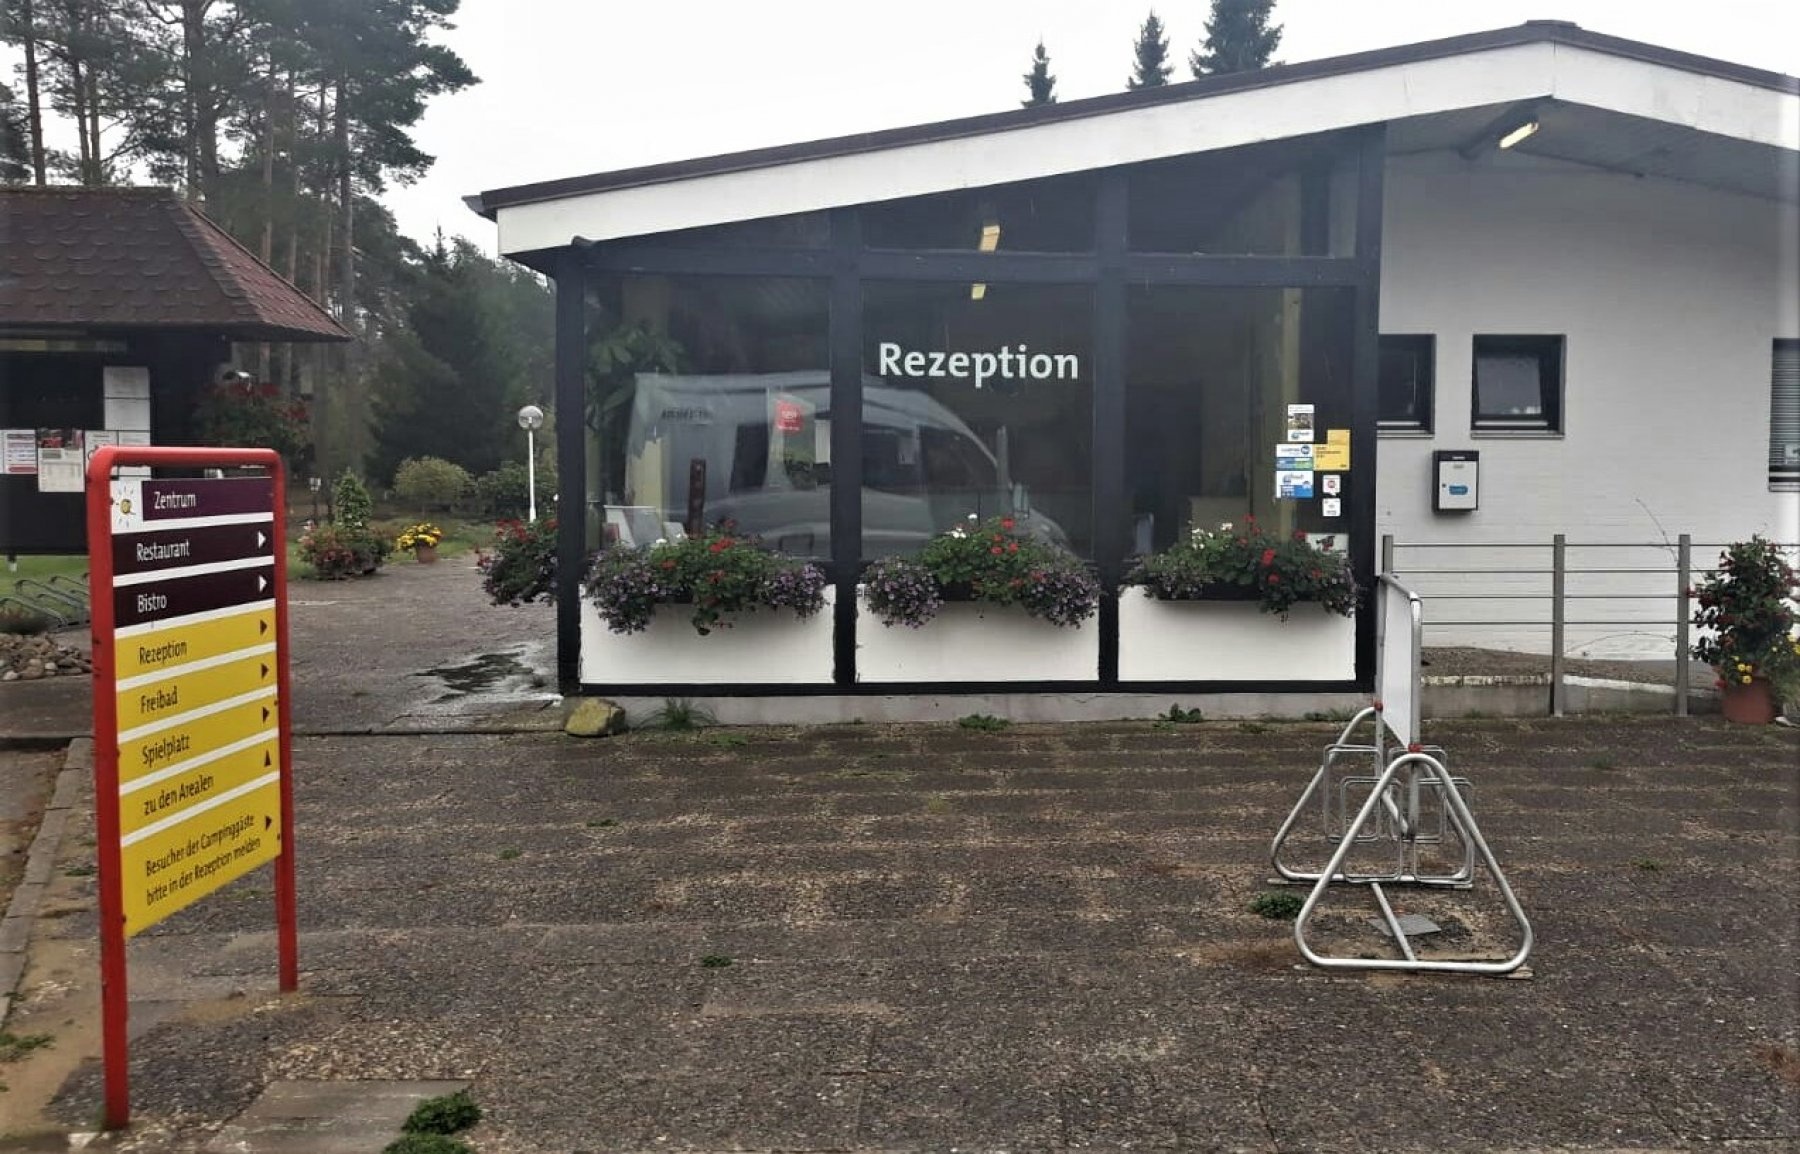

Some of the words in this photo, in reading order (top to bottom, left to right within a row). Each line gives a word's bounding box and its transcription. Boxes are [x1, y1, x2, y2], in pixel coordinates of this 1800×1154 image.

[879, 342, 1078, 389] Rezeption
[154, 491, 196, 510] Zentrum
[136, 540, 190, 562] Restaurant
[137, 594, 168, 614] Bistro
[139, 640, 187, 665] Rezeption
[140, 686, 178, 714] Freibad
[142, 734, 190, 767] Spielplatz
[144, 799, 157, 816] zu
[158, 788, 178, 810] den
[179, 775, 214, 802] Arealen
[146, 847, 185, 877] Besucher
[186, 841, 201, 858] der
[201, 815, 254, 849] Campinggäste
[146, 882, 168, 906] bitte
[169, 874, 178, 891] in
[178, 868, 194, 889] der
[194, 850, 233, 881] Rezeption
[234, 836, 261, 863] melden
